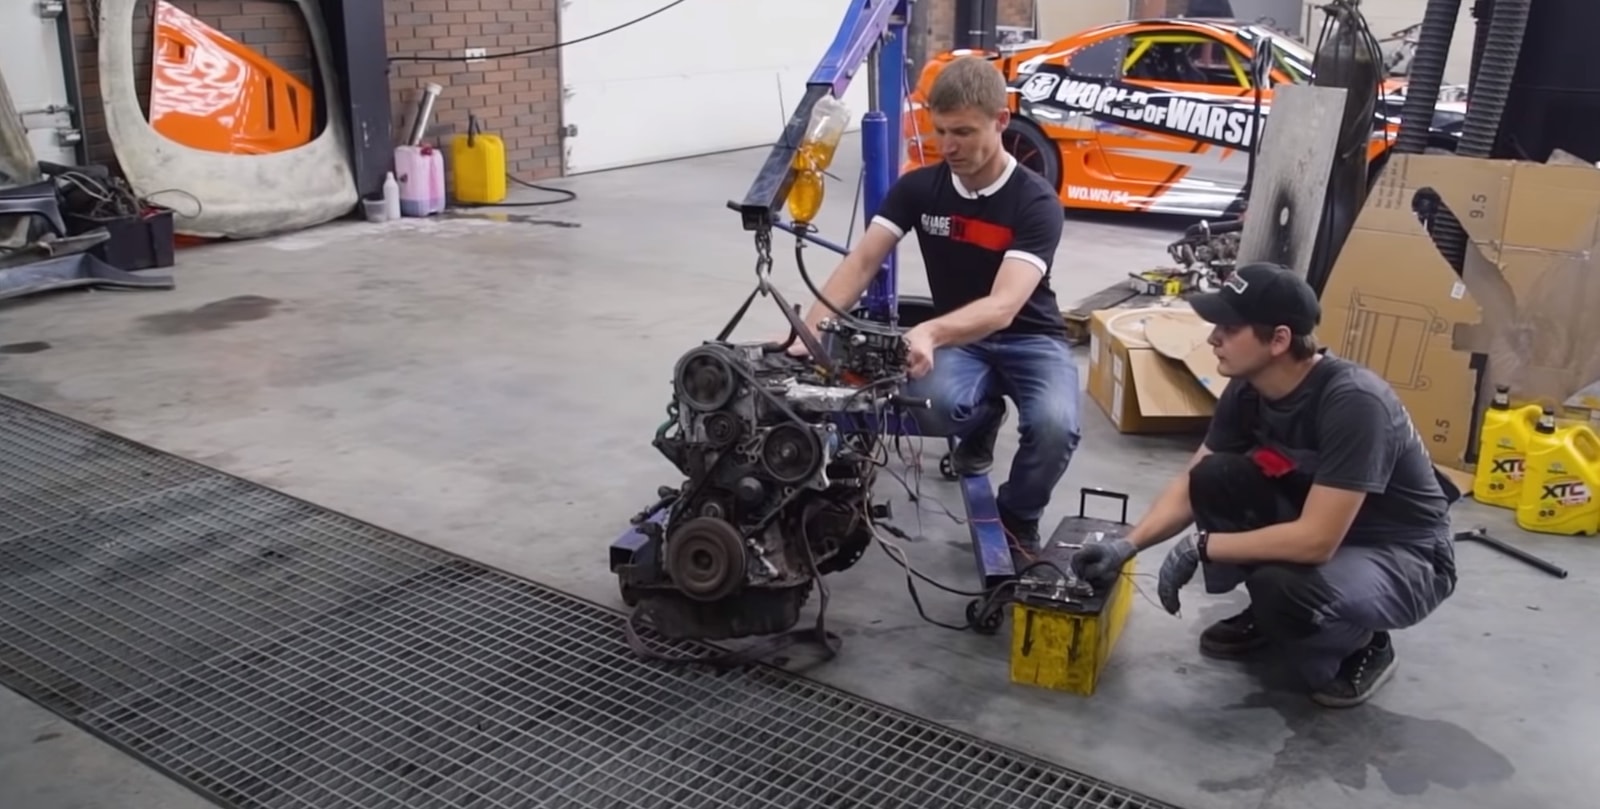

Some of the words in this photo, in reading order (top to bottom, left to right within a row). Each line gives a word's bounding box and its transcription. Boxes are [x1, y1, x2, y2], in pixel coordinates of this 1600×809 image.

[1055, 79, 1148, 121] WORLD
[1143, 104, 1168, 125] OF
[1469, 193, 1487, 219] 9.5
[1432, 418, 1450, 444] 9.5
[1540, 481, 1586, 500] XTC
